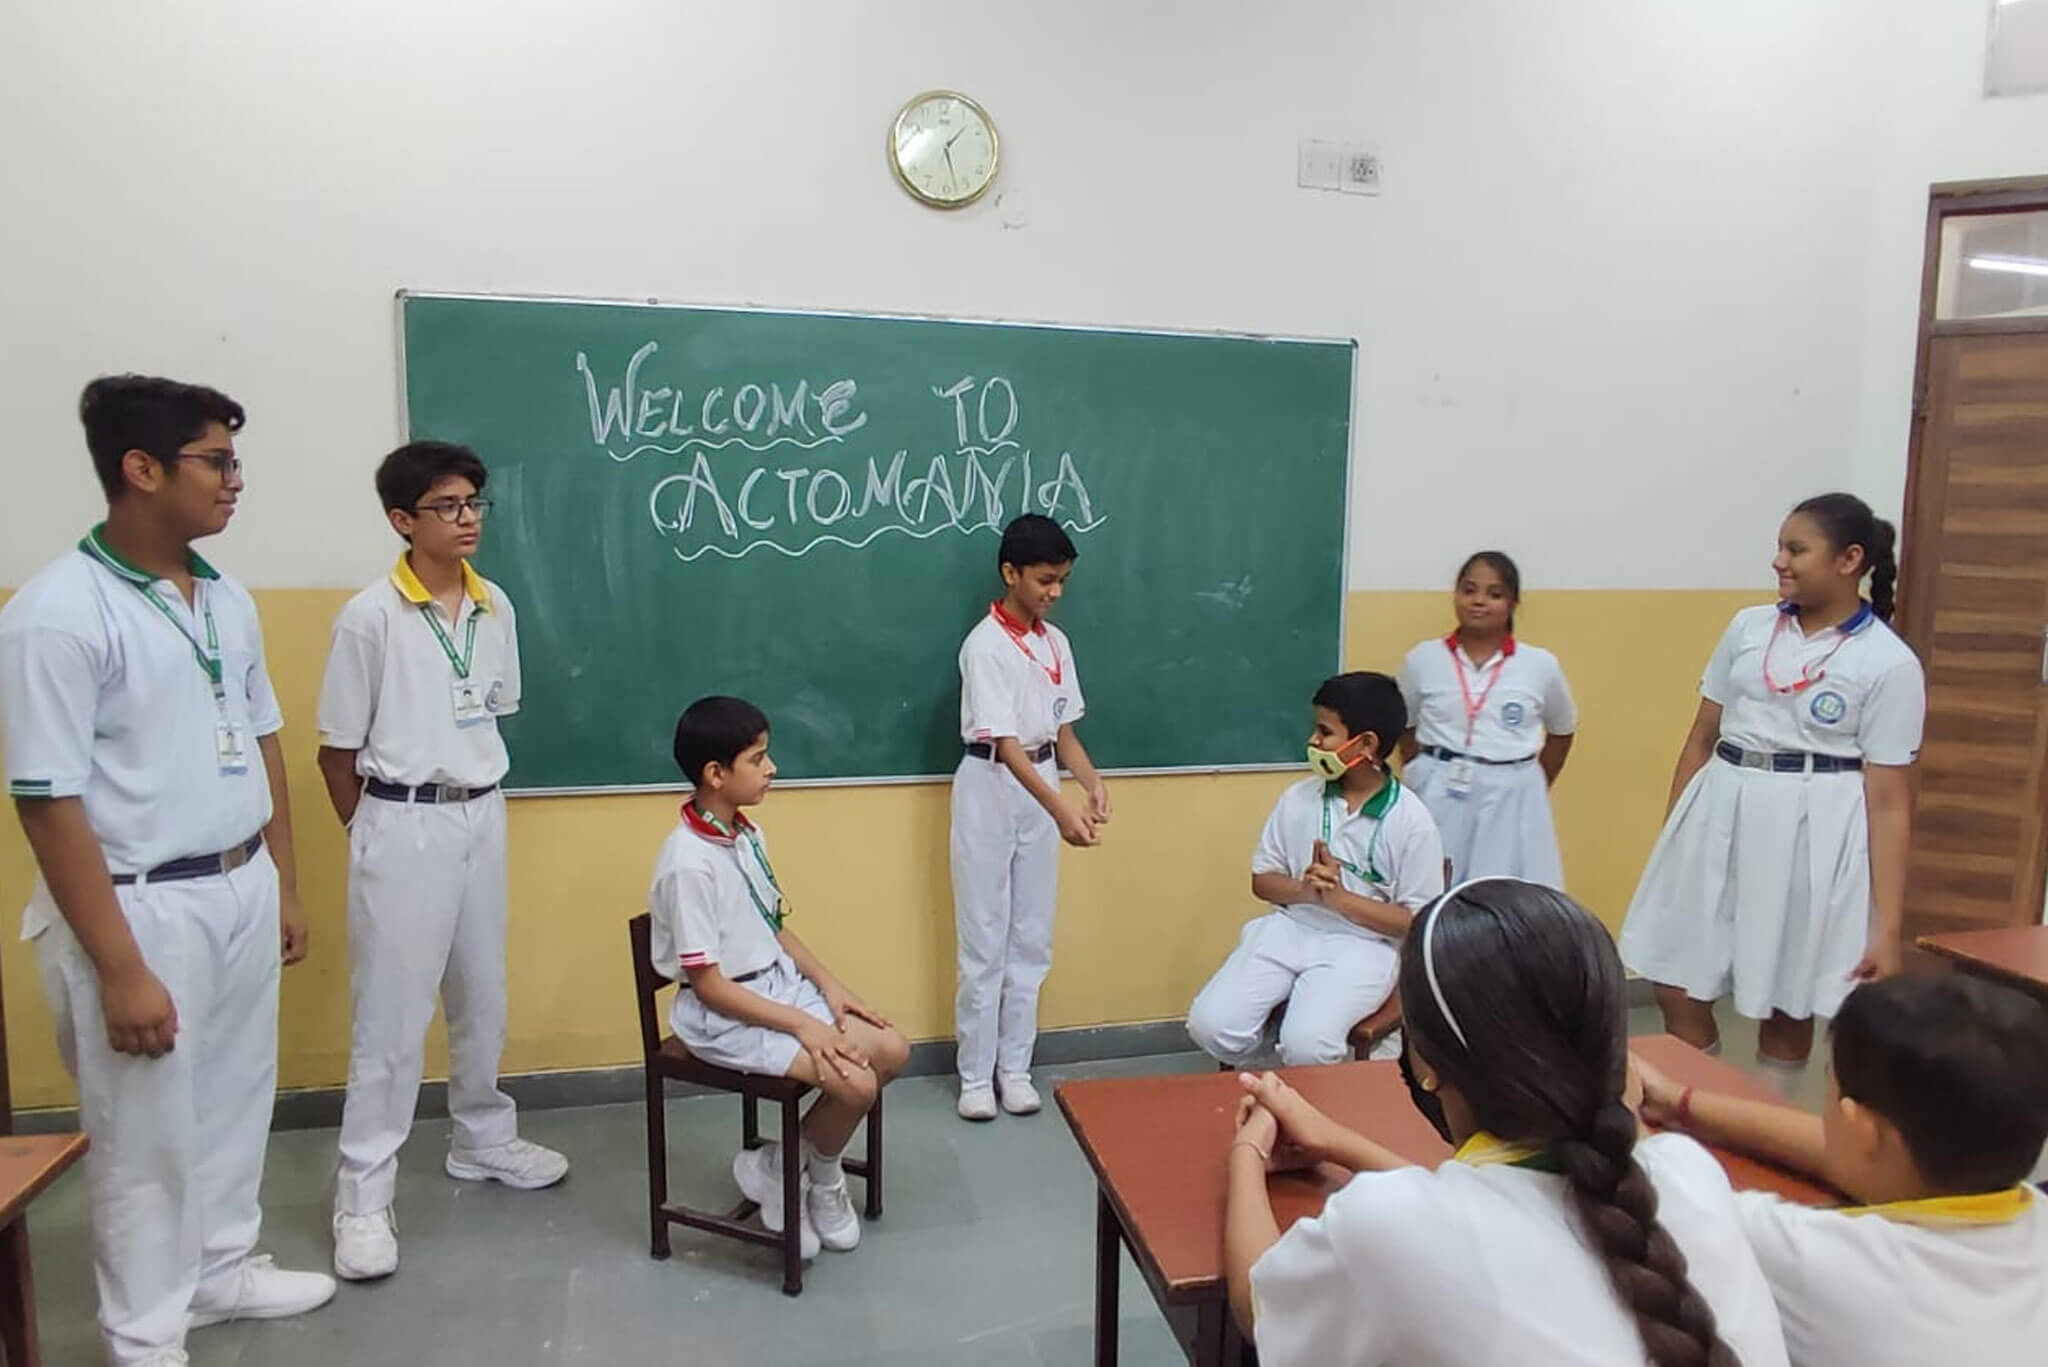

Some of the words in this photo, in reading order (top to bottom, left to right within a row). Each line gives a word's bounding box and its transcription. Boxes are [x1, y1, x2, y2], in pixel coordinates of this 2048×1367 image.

[576, 341, 867, 446] WELCOME
[932, 376, 1020, 447] TO
[649, 449, 1094, 539] ACTOMANIA
